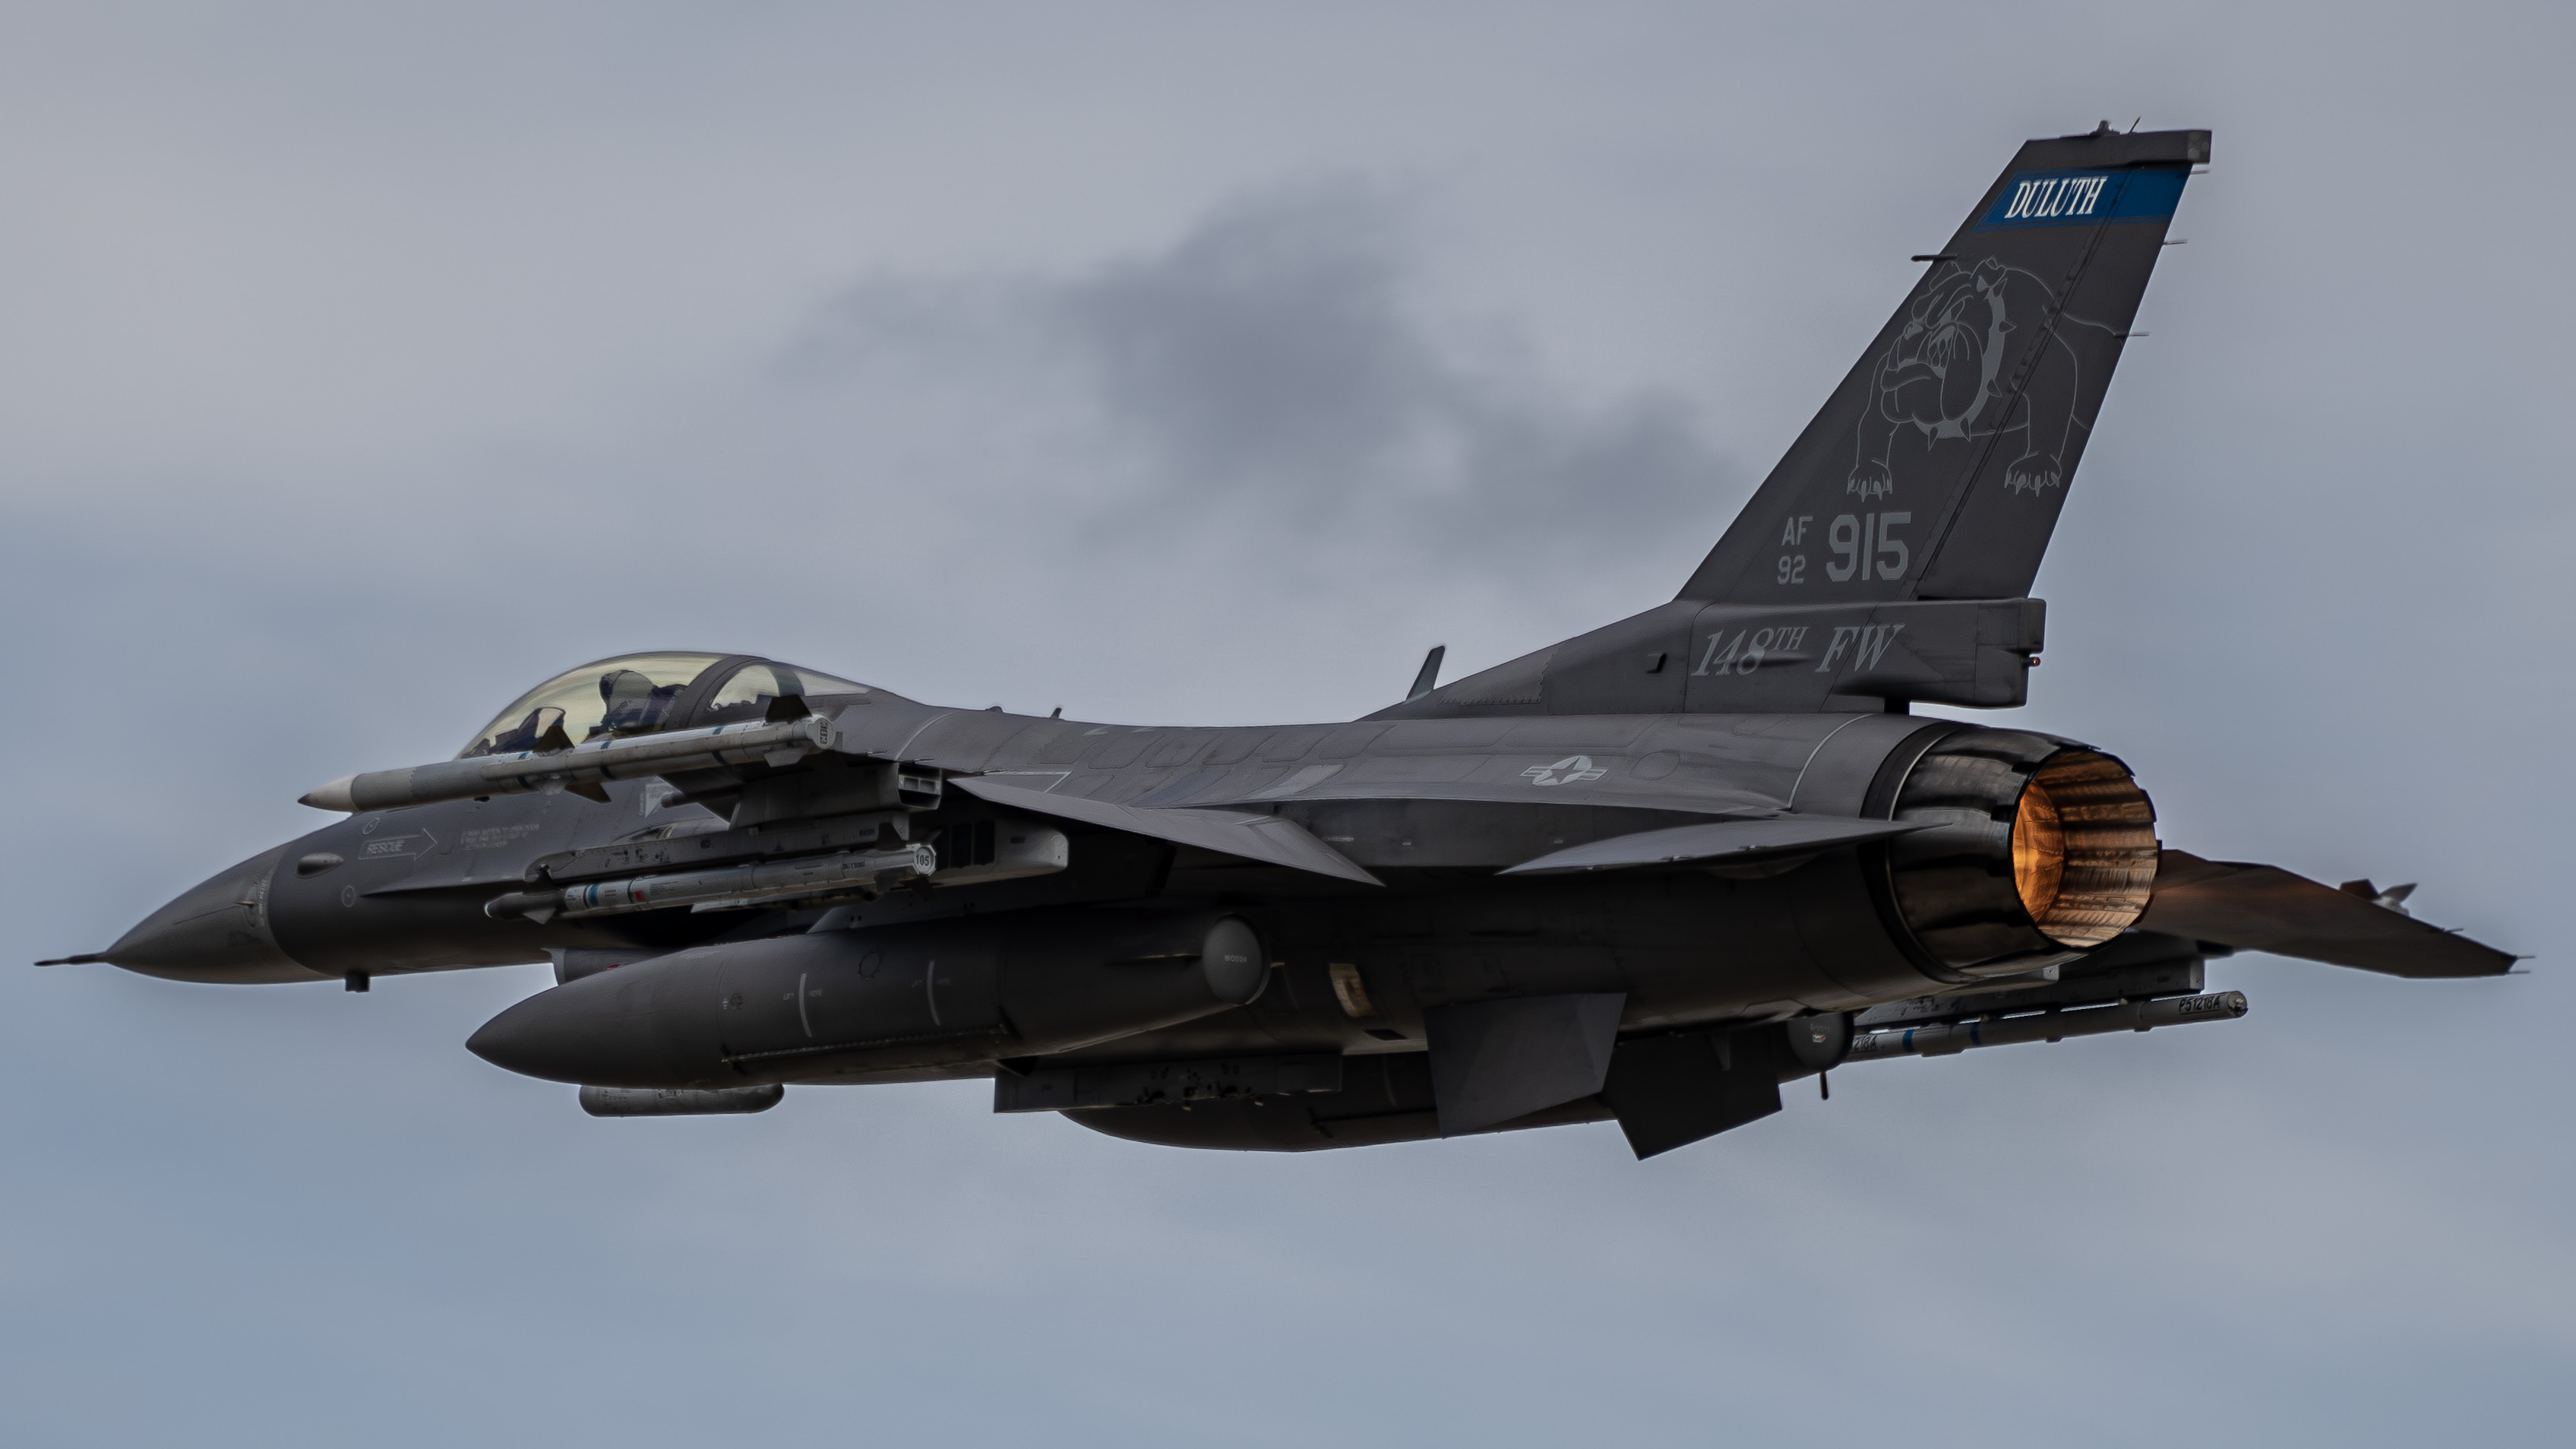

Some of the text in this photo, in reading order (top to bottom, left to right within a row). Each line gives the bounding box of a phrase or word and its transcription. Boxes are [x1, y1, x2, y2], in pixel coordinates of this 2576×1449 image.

[2003, 175, 2109, 220] DULUTH
[1781, 515, 1813, 547] AF
[1825, 511, 1912, 583] 915
[1776, 554, 1806, 585] 92
[1690, 623, 1906, 677] 148TH FW
[916, 854, 930, 866] 105
